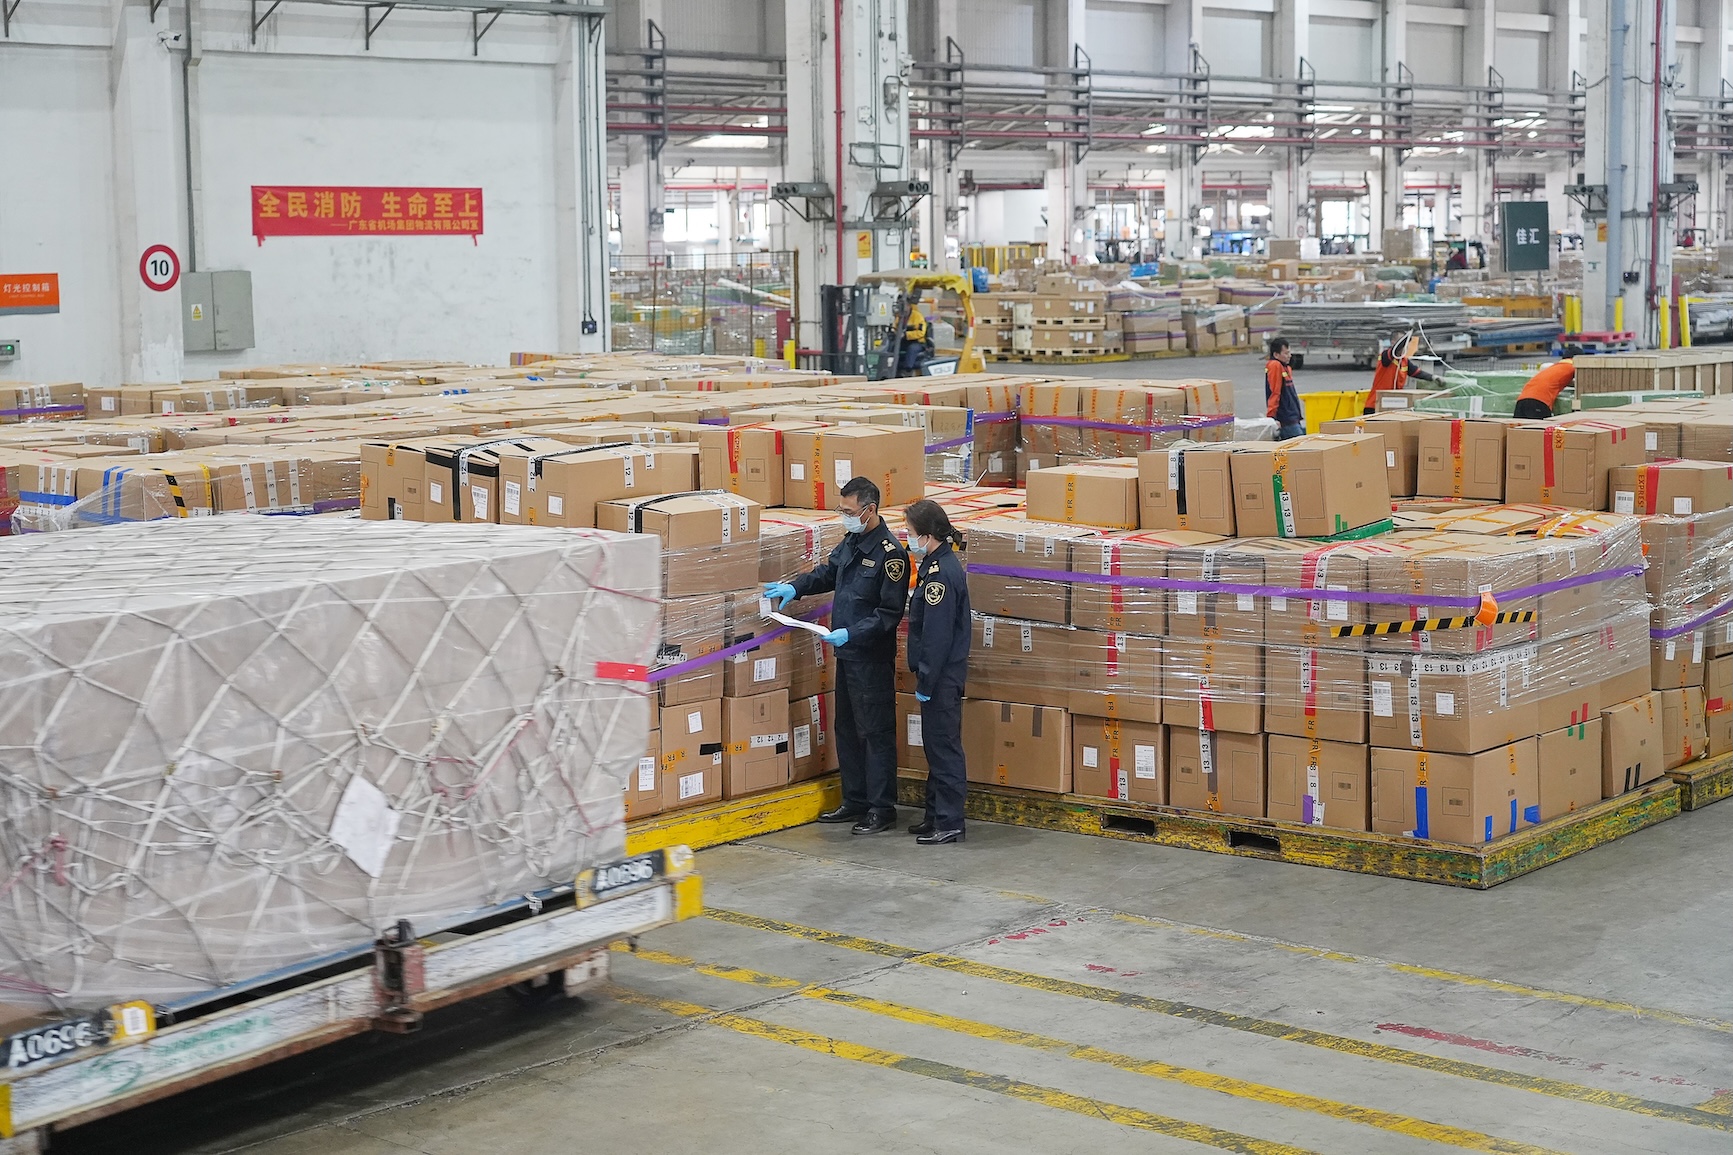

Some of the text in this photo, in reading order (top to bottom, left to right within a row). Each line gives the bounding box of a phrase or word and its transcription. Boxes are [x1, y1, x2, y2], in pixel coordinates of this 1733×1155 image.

[258, 191, 479, 218] 全民消防 生命至上
[1516, 227, 1540, 246] 佳汇
[150, 259, 169, 276] 10
[3, 282, 50, 293] 灯光控制箱
[625, 467, 631, 476] 12
[1068, 482, 1073, 491] FR
[1454, 485, 1460, 493] FR
[1544, 489, 1549, 498] FR
[1067, 499, 1073, 509] FR
[628, 511, 634, 520] 12
[1282, 493, 1293, 533] 13 13 13
[740, 507, 746, 532] 12 12
[1180, 517, 1187, 527] FR
[722, 512, 728, 537] 12 12
[1205, 554, 1212, 563] 13
[1104, 562, 1109, 570] 13
[1313, 602, 1319, 611] 13
[986, 627, 992, 637] 13
[1023, 630, 1029, 639] 13
[1118, 637, 1123, 647] 13
[1303, 662, 1309, 671] 13
[1108, 702, 1114, 710] FR
[1410, 679, 1420, 739] 13 13 13 13
[1308, 720, 1314, 730] FR
[1113, 730, 1119, 757] FR FR
[1202, 744, 1209, 753] 13
[1204, 761, 1210, 769] 13
[1000, 776, 1005, 784] FR
[1120, 778, 1126, 786] 13
